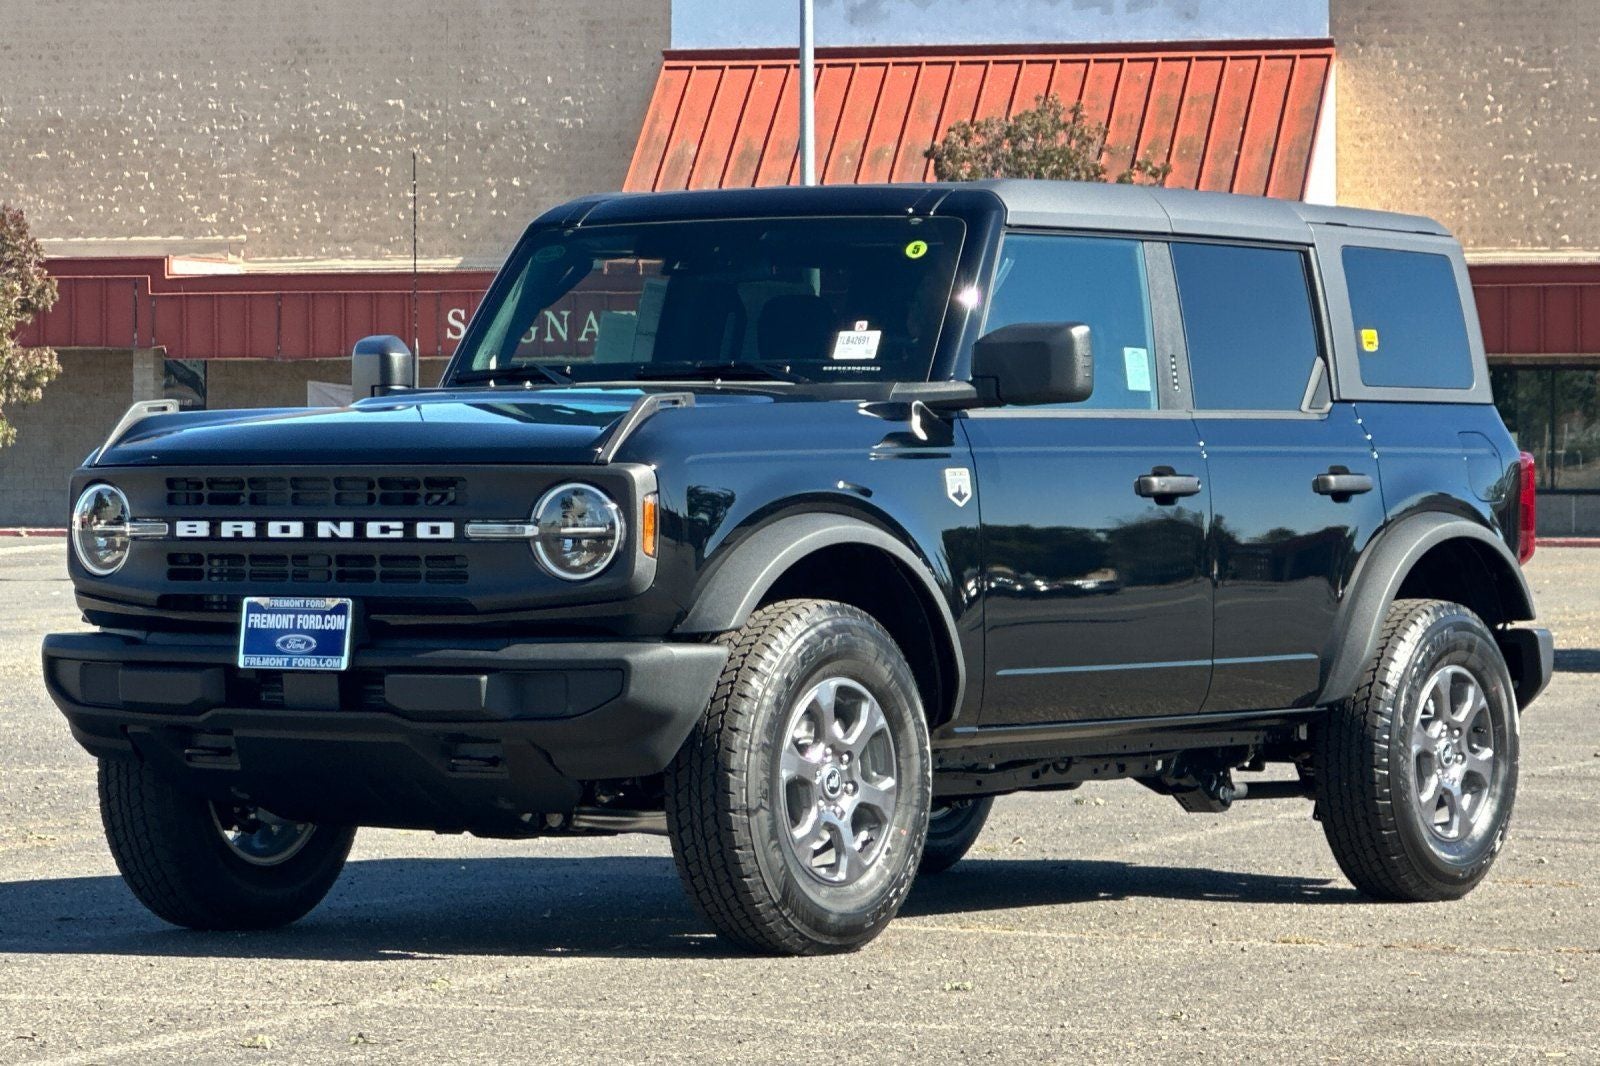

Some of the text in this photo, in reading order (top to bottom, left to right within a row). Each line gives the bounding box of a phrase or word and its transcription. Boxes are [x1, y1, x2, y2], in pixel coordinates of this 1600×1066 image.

[912, 245, 920, 254] 5
[175, 520, 455, 539] BRONCO
[270, 600, 326, 608] FREMONT FORD
[248, 613, 345, 629] FREMONT FORD.COM
[286, 638, 307, 650] Ford
[244, 657, 340, 668] FREMONT FORD.COM
